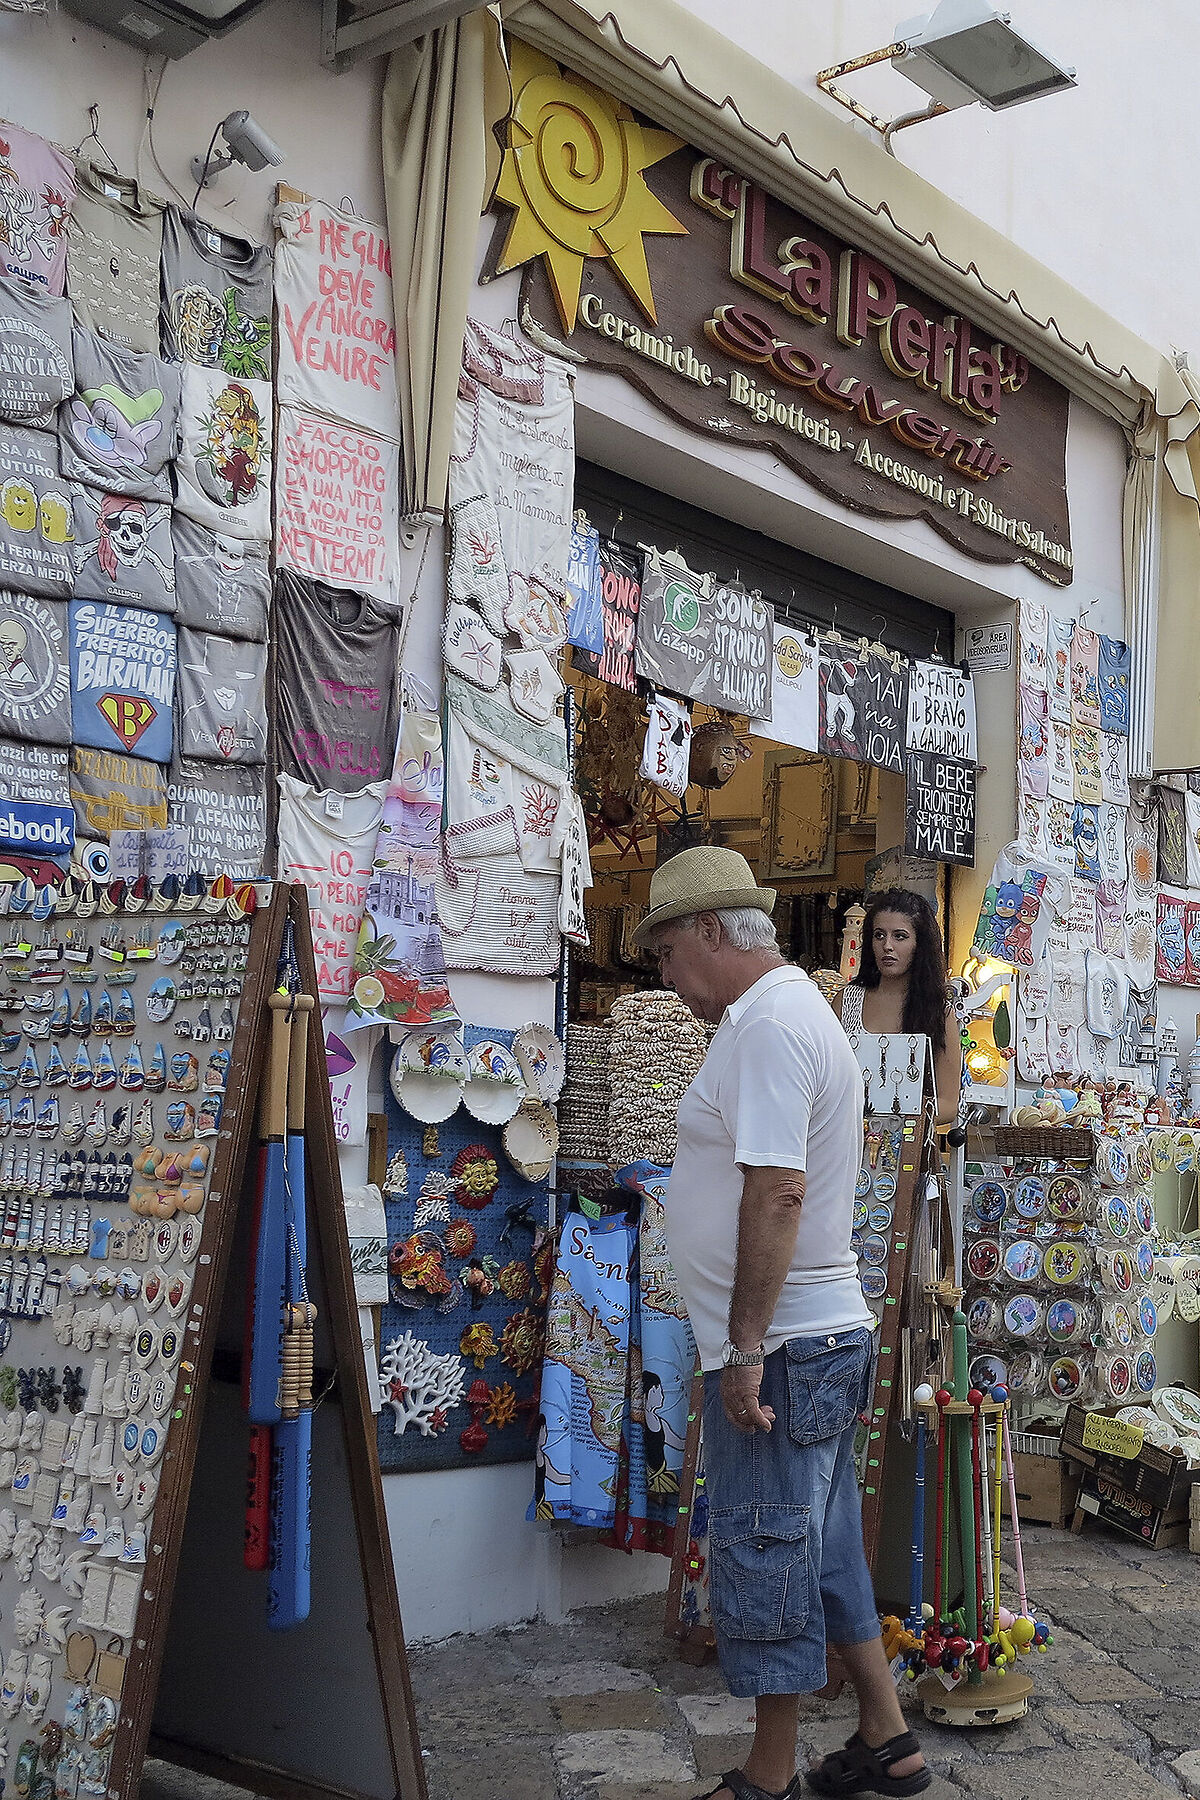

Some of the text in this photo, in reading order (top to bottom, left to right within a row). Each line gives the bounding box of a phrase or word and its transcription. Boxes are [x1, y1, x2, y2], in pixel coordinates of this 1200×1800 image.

[318, 264, 376, 309] DEVE
[283, 300, 390, 391] VENIRE
[0, 352, 61, 377] ANCIA
[0, 388, 50, 402] AGLIETTA
[578, 293, 712, 388] Ceramiche
[728, 370, 842, 453] Bigiotteria
[854, 437, 944, 502] Accessori
[703, 304, 1014, 482] Souvenir
[0, 442, 23, 457] SA
[296, 421, 380, 462] FACCIO
[0, 458, 67, 483] UTURO...
[284, 435, 385, 493] SHOPPING
[285, 467, 383, 514] DA UNA VITA
[307, 498, 349, 523] NON
[355, 512, 383, 531] HO
[310, 517, 364, 543] NIENTE
[367, 532, 386, 548] DA
[0, 559, 36, 576] ERZA
[104, 604, 158, 628] IL MIO
[715, 588, 767, 631] SONO
[74, 604, 176, 650] SUPEREROE
[989, 632, 1008, 644] AREA
[75, 633, 165, 669] PREFERITO
[713, 622, 767, 668] STRONZO
[76, 650, 176, 708] BARMAN
[720, 662, 767, 712] ALLORA?
[910, 668, 966, 699] HO FATTO
[3, 700, 40, 721] ENTE
[912, 695, 966, 729] IL BRAVO
[911, 730, 918, 749] A
[27, 747, 49, 765] che
[51, 754, 69, 765] no
[73, 748, 139, 786] STASERA
[401, 750, 443, 794] Sa
[915, 759, 974, 795] IL BERE
[11, 781, 19, 797] il
[20, 786, 52, 801] resto
[167, 784, 264, 812] QUANDO LA VITA
[0, 812, 72, 845] ebook
[170, 803, 186, 823] TI
[194, 807, 261, 832] AFFANNA
[915, 810, 974, 834] SEMPRE SUL
[198, 826, 223, 845] UNA
[187, 858, 208, 877] NA
[189, 843, 234, 862] UMA...
[327, 881, 367, 907] PERF
